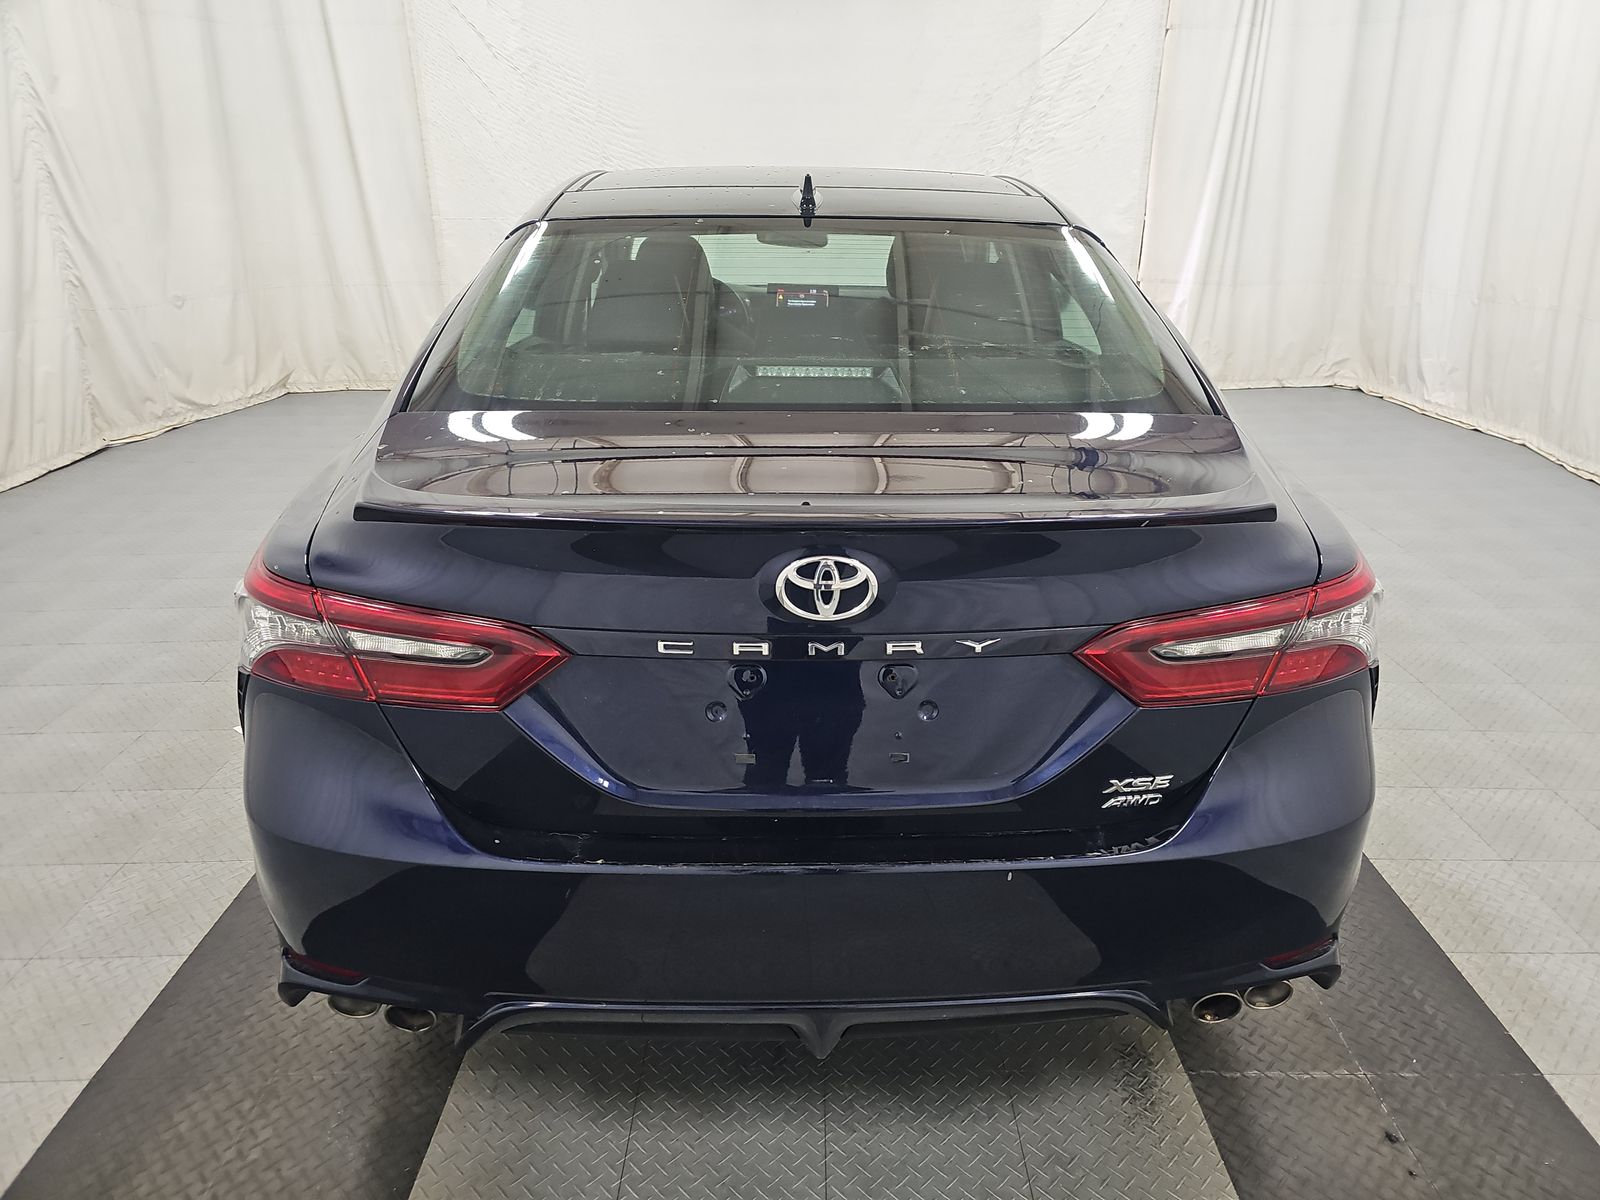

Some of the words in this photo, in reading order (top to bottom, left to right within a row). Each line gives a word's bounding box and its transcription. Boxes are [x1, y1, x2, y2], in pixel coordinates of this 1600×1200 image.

[657, 637, 1002, 656] CAMRY
[1102, 775, 1174, 794] XSE
[1101, 793, 1162, 808] AWD
